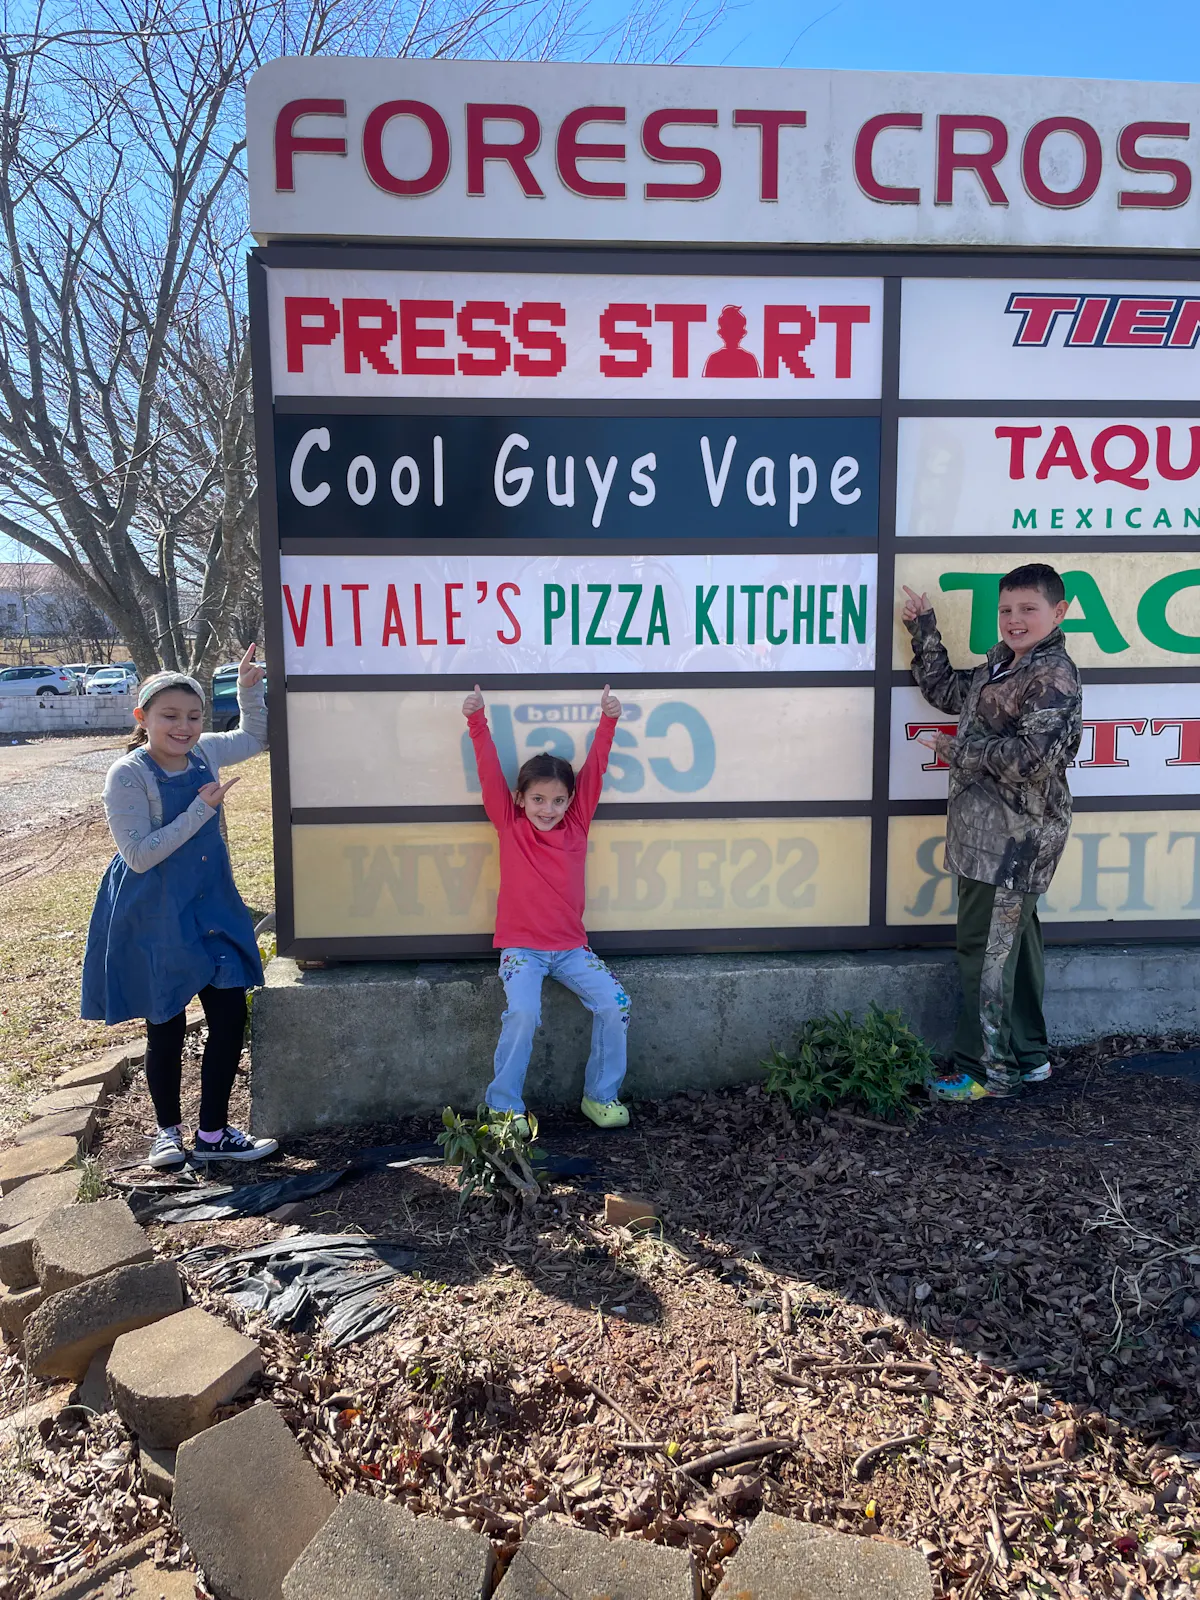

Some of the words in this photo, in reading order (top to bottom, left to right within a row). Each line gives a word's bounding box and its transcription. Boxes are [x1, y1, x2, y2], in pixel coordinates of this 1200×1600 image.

[274, 98, 807, 203] FOREST
[853, 112, 1193, 209] CROS
[285, 297, 567, 377] PRESS
[599, 304, 871, 379] STRT
[290, 427, 444, 507] Cool
[494, 433, 657, 529] Guys
[700, 435, 862, 528] Vape
[994, 424, 1200, 490] TAQU
[1012, 507, 1200, 529] MEXICAN
[282, 581, 522, 648] VITALE'S
[543, 583, 671, 646] PIZZA
[695, 584, 868, 646] KITCHEN
[905, 718, 1200, 772] TTT
